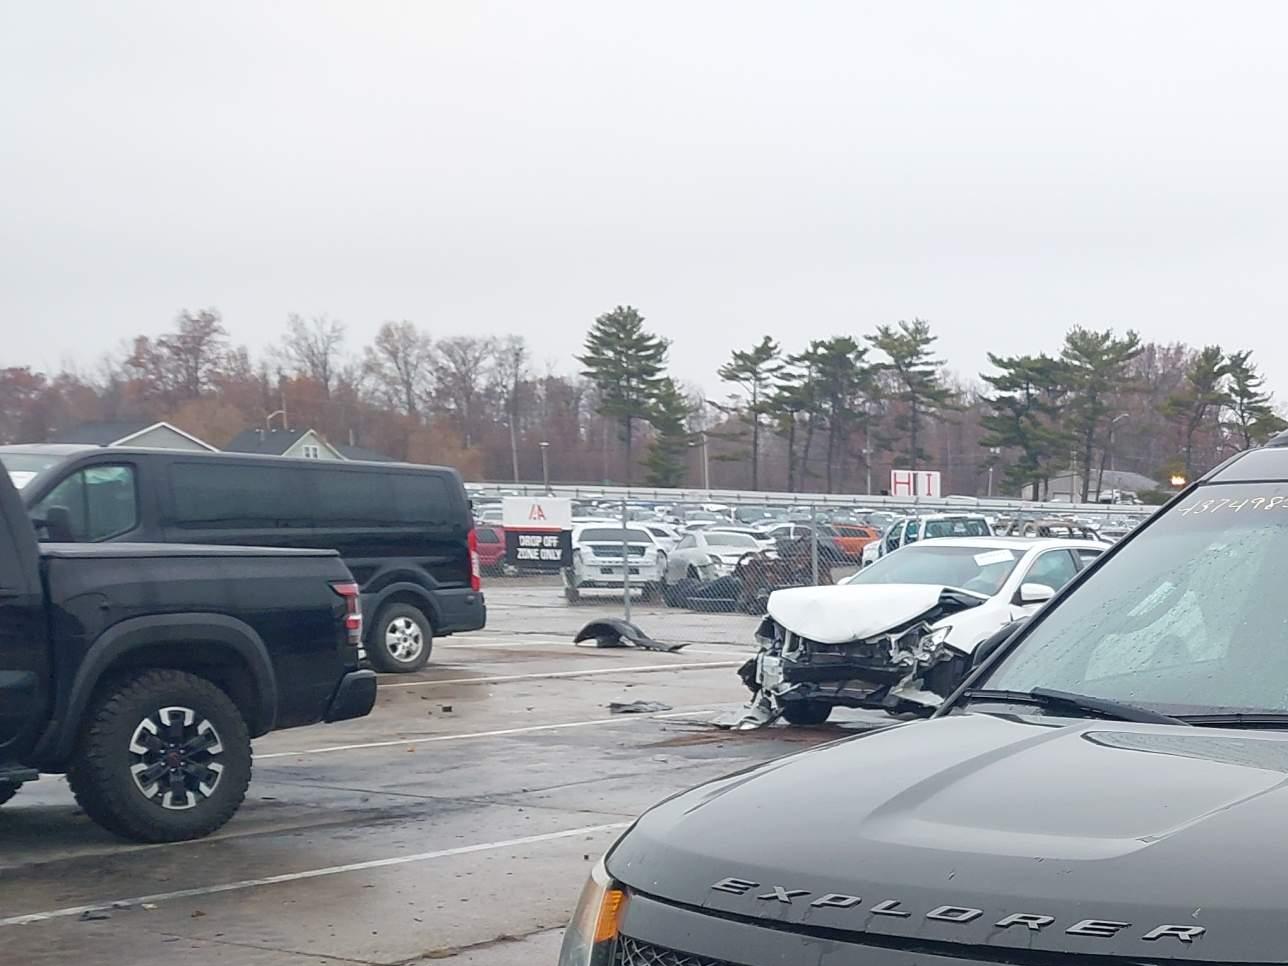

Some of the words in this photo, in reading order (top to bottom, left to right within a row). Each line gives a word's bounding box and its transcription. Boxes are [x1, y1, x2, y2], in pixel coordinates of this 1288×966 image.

[518, 535, 542, 547] DROP
[543, 535, 559, 547] OFF
[516, 548, 540, 560] ZONE
[540, 549, 562, 560] ONLY
[711, 876, 1207, 943] EXPLORER
